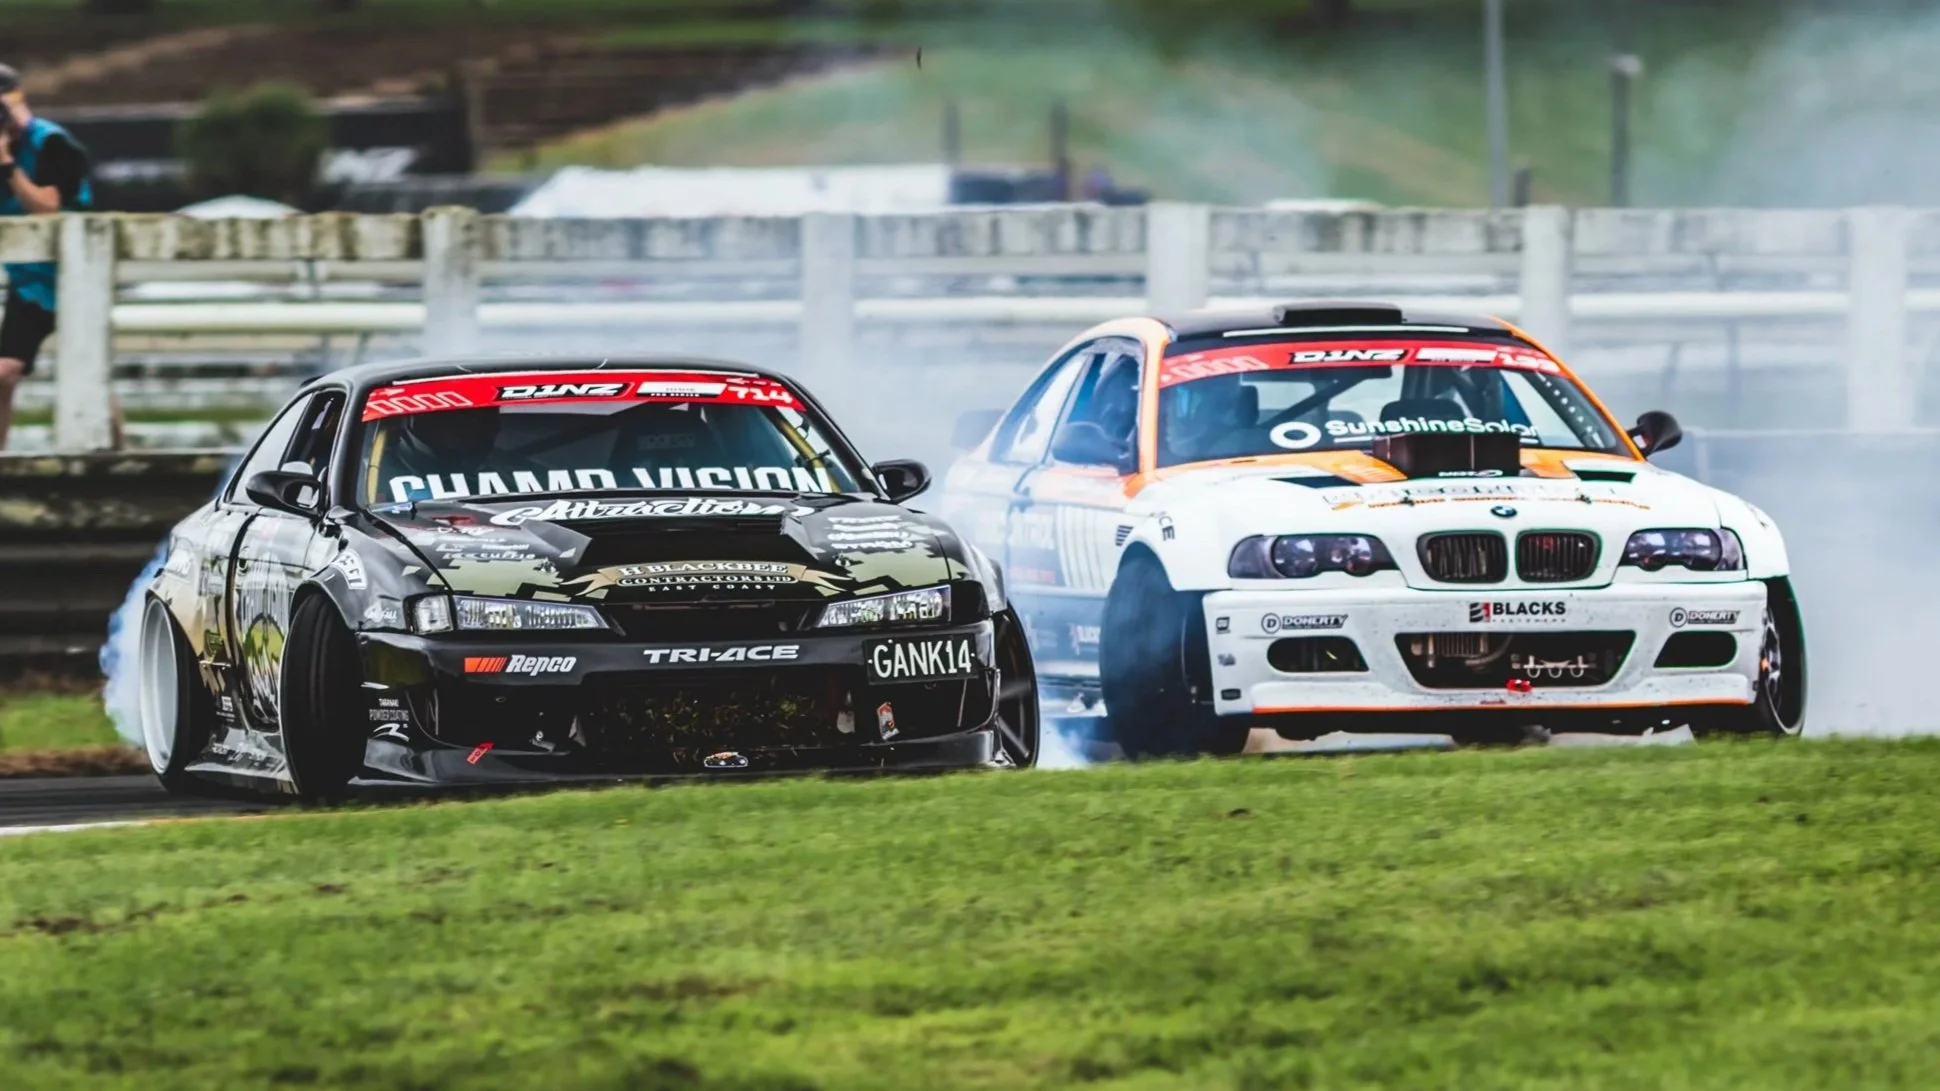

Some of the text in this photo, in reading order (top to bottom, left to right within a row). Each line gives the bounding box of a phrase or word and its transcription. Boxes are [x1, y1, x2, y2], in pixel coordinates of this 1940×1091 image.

[1293, 349, 1404, 363] D1NZ
[501, 383, 625, 399] D1NZ
[727, 386, 793, 403] 714
[617, 562, 789, 577] H BLACKBEE
[621, 575, 792, 586] CONTRACTORS LTD
[1492, 601, 1566, 615] BLACKS
[1688, 610, 1740, 620] DOHERTY
[1283, 614, 1348, 626] DOHERTY
[643, 644, 800, 664] TRI-ACE
[873, 639, 972, 679] GANK14
[505, 654, 577, 676] Repco
